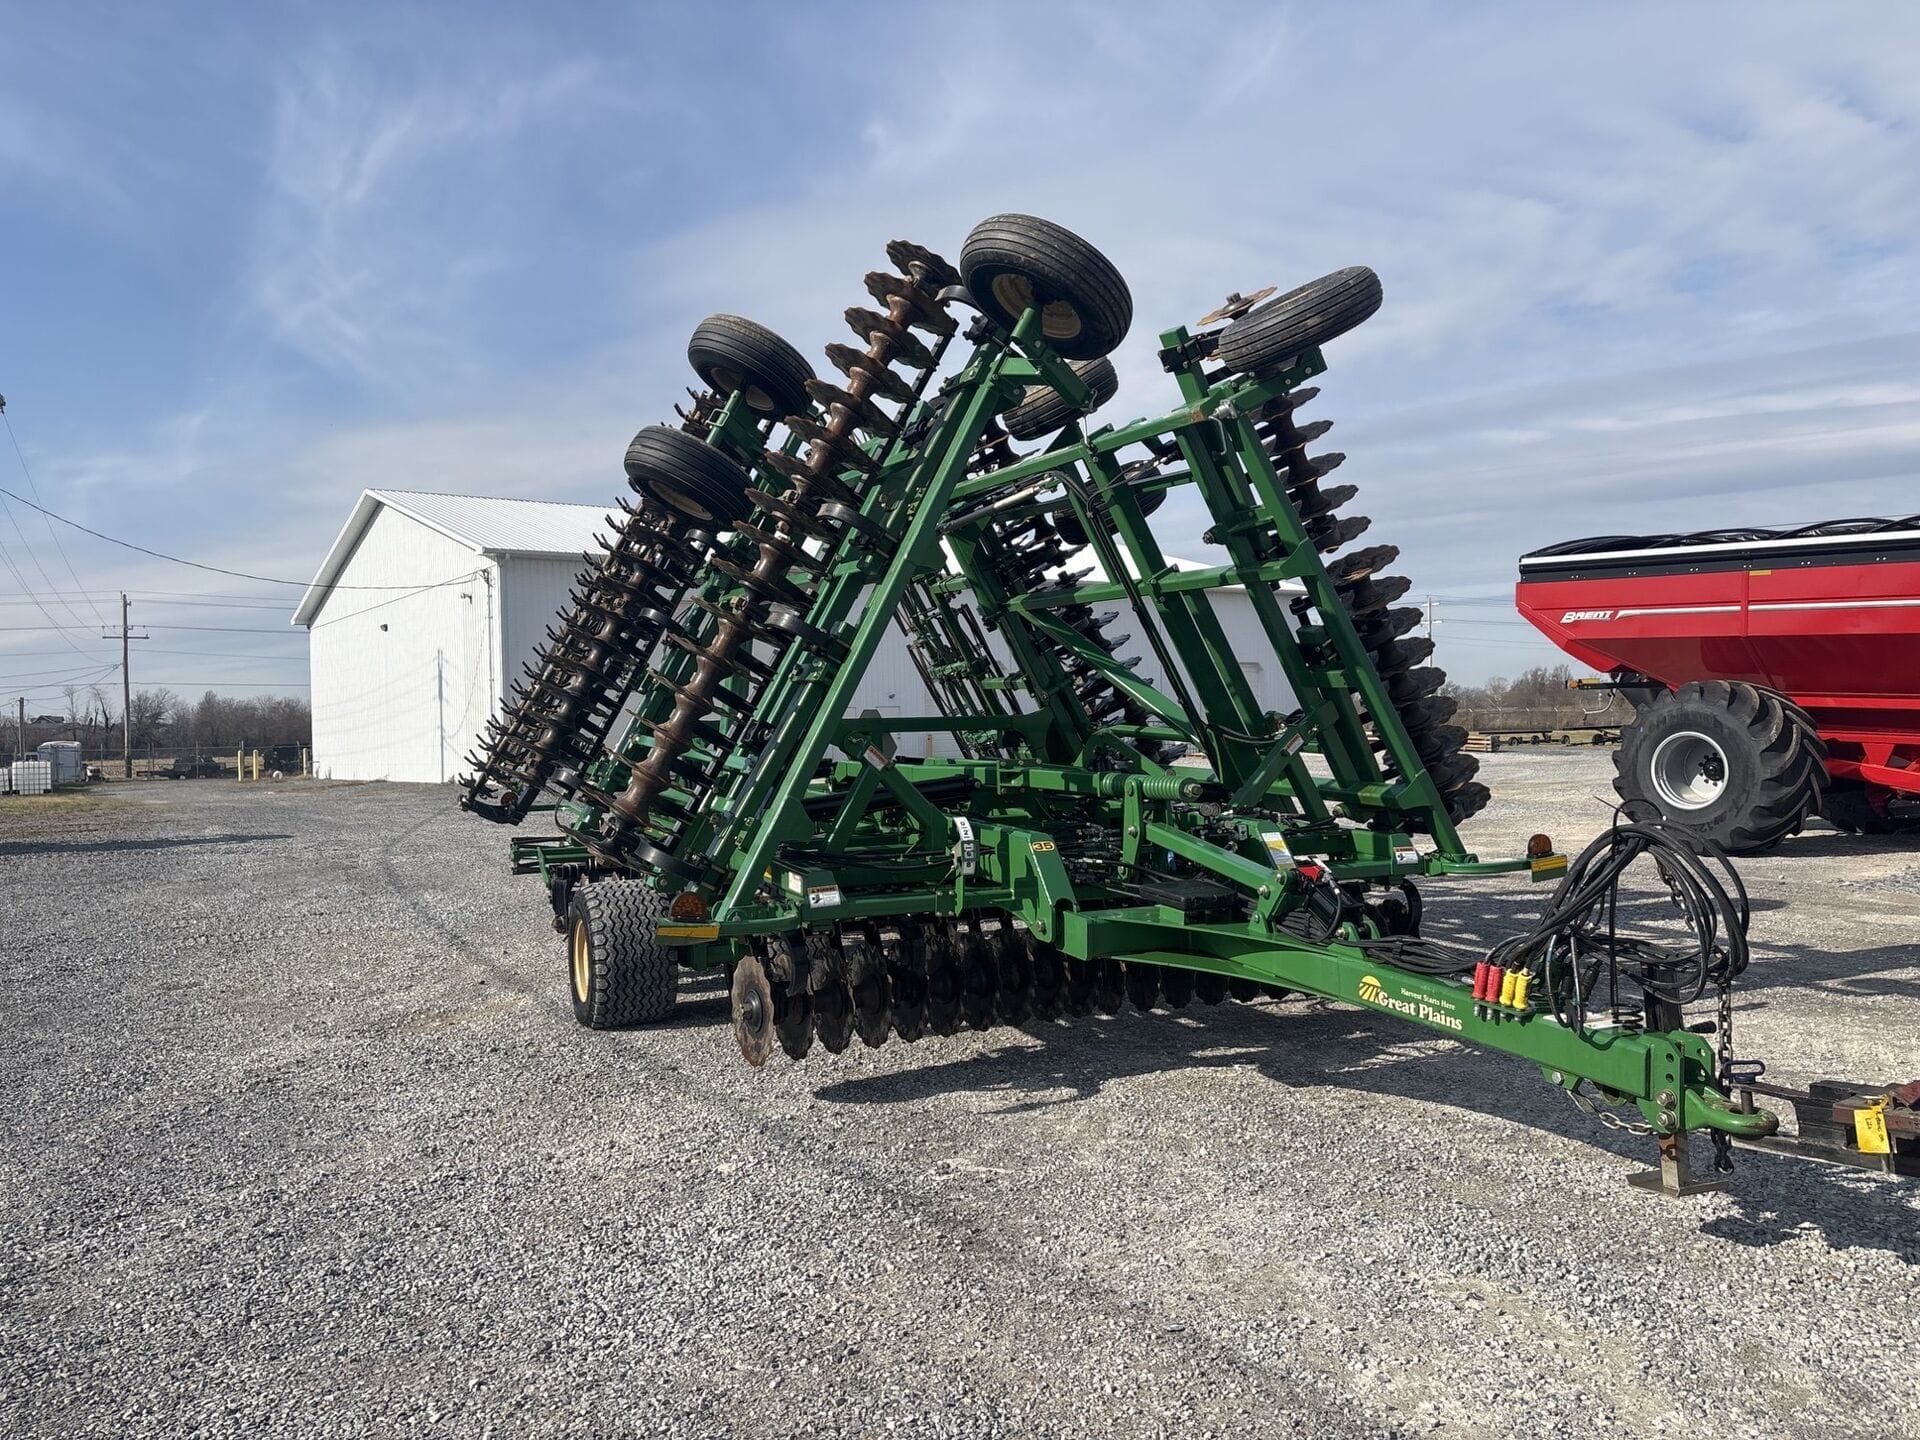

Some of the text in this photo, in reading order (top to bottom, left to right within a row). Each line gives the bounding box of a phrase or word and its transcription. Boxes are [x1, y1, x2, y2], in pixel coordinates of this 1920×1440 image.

[1560, 610, 1614, 623] BRENT
[1033, 842, 1053, 850] 35
[1401, 988, 1455, 1010] Harvest Starts Here
[1378, 991, 1462, 1030] Great Plains
